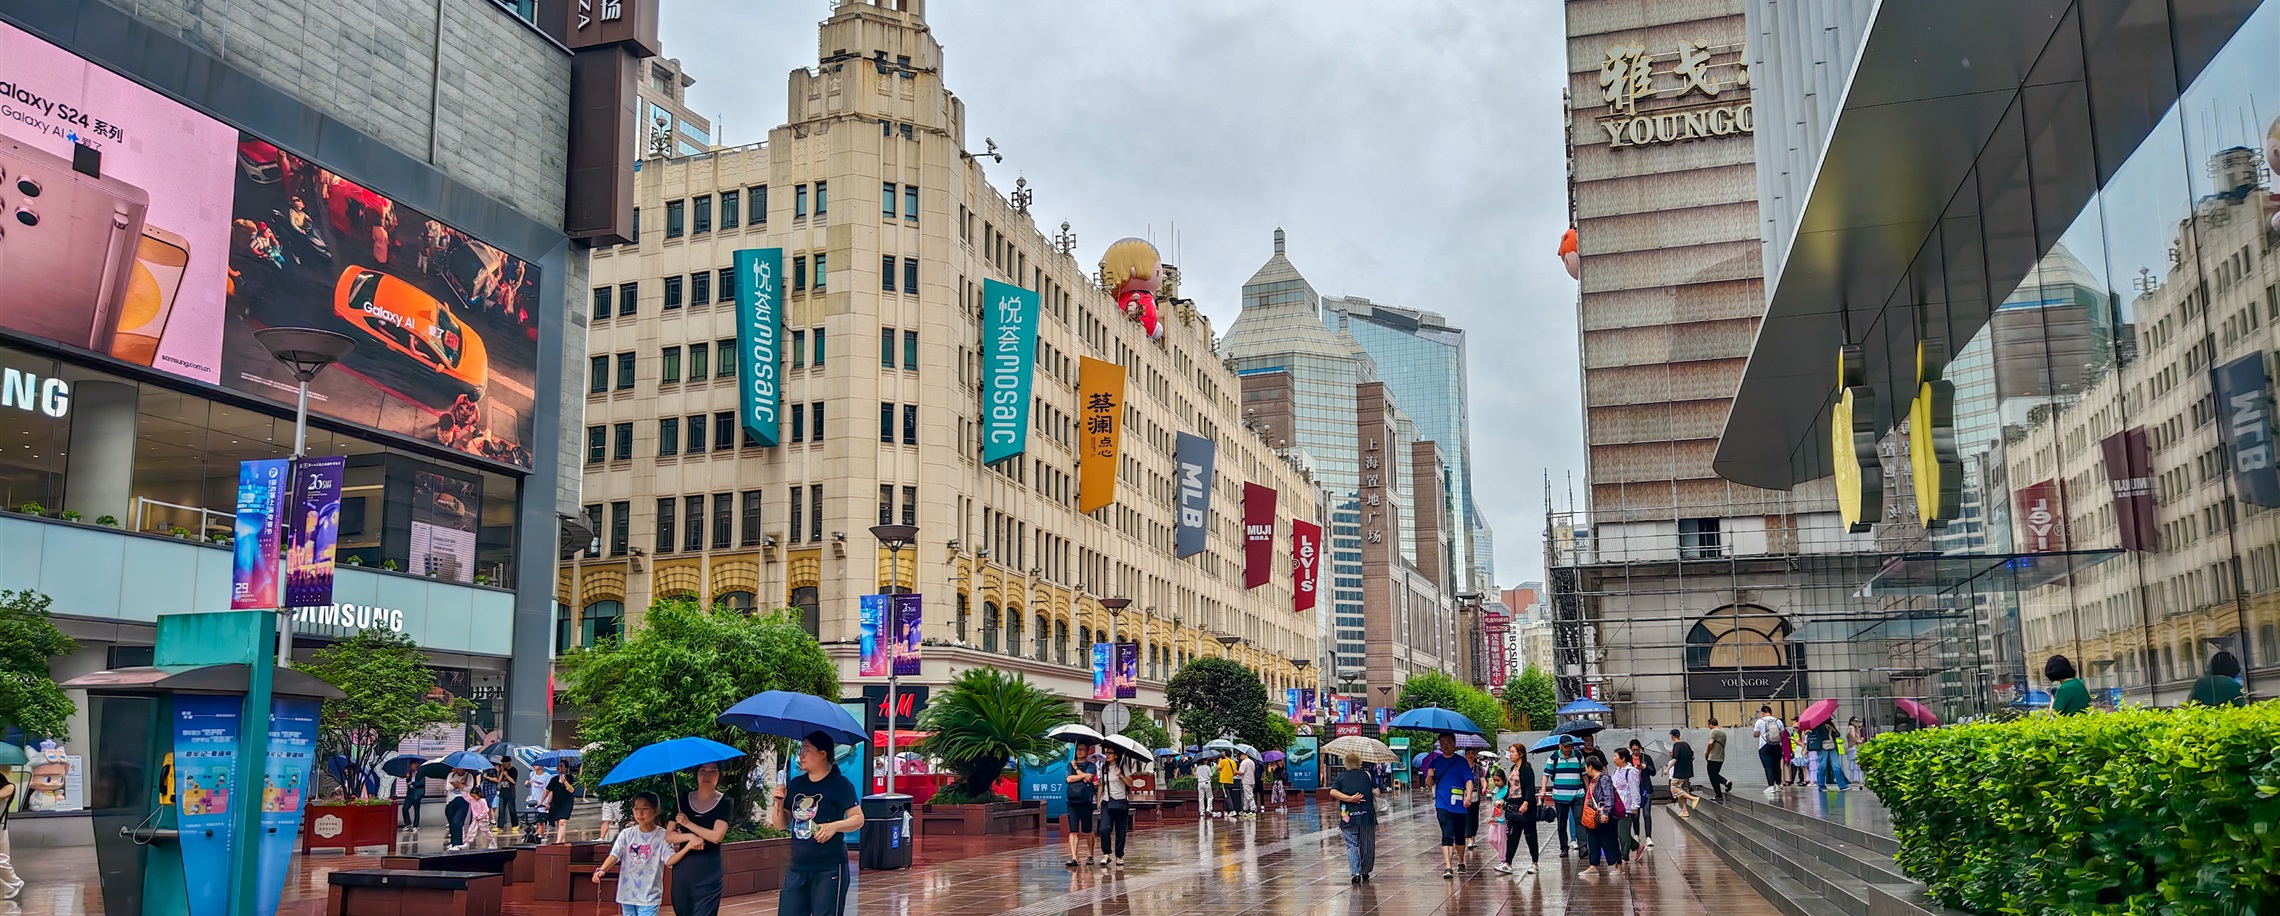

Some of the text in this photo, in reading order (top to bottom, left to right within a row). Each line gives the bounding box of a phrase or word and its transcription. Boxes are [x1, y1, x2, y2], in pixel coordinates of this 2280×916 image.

[1600, 38, 1749, 117] 雅戈
[1, 104, 50, 135] Galaxy
[52, 125, 65, 139] AI
[57, 103, 90, 129] S24
[93, 118, 124, 144] 系列
[363, 301, 403, 328] Galaxy
[404, 316, 416, 329] AI
[997, 295, 1023, 353] 悦荟
[161, 354, 211, 374] samsung.com.cn
[1, 367, 69, 418] NG
[1181, 461, 1203, 529] MLB
[1364, 437, 1382, 545] 上海置地广场
[1247, 524, 1272, 536] MUJI
[235, 582, 249, 594] 29
[292, 602, 404, 633] AMSUNG
[1720, 678, 1770, 687] YOUNGOR
[1050, 783, 1063, 792] S7
